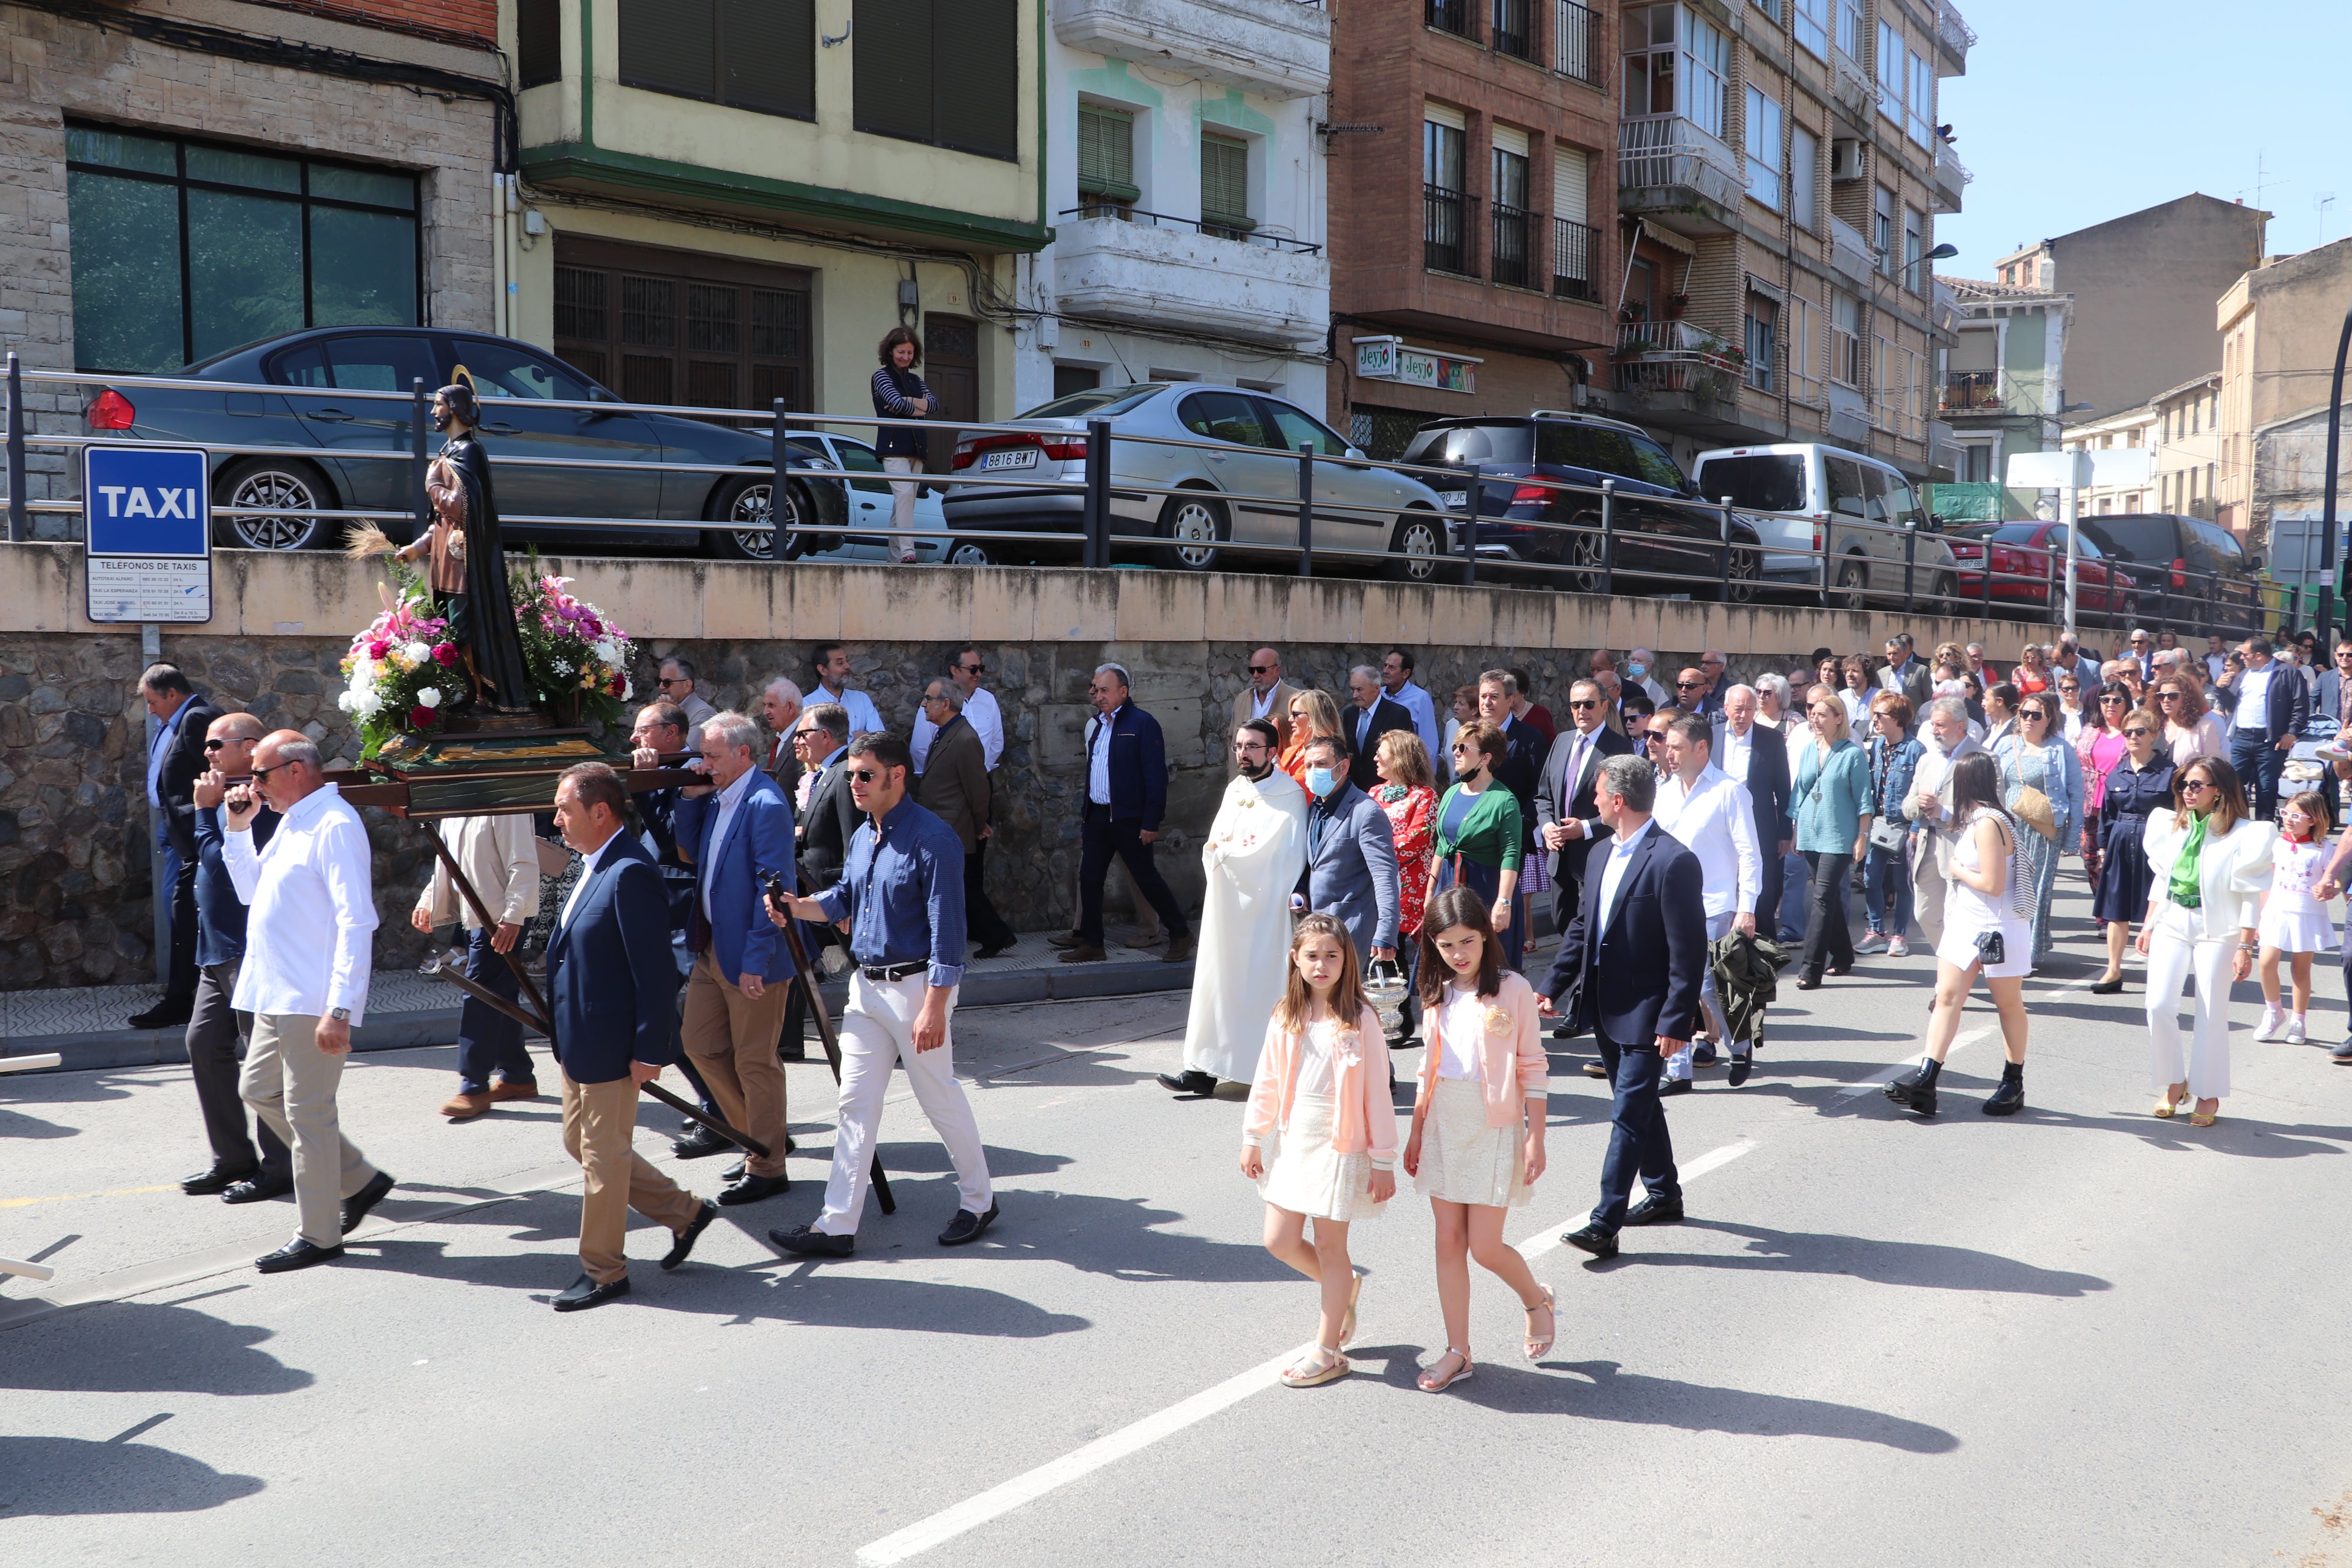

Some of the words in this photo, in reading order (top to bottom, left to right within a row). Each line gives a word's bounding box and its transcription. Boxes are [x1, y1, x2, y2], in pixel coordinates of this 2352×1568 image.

[988, 453, 1012, 466] 8816
[1015, 452, 1035, 465] BWT
[98, 485, 196, 520] TAXI
[1440, 493, 1451, 502] 90
[1454, 492, 1466, 501] JC
[100, 560, 154, 570] TELÉFONOS
[172, 563, 197, 571] TAXIS
